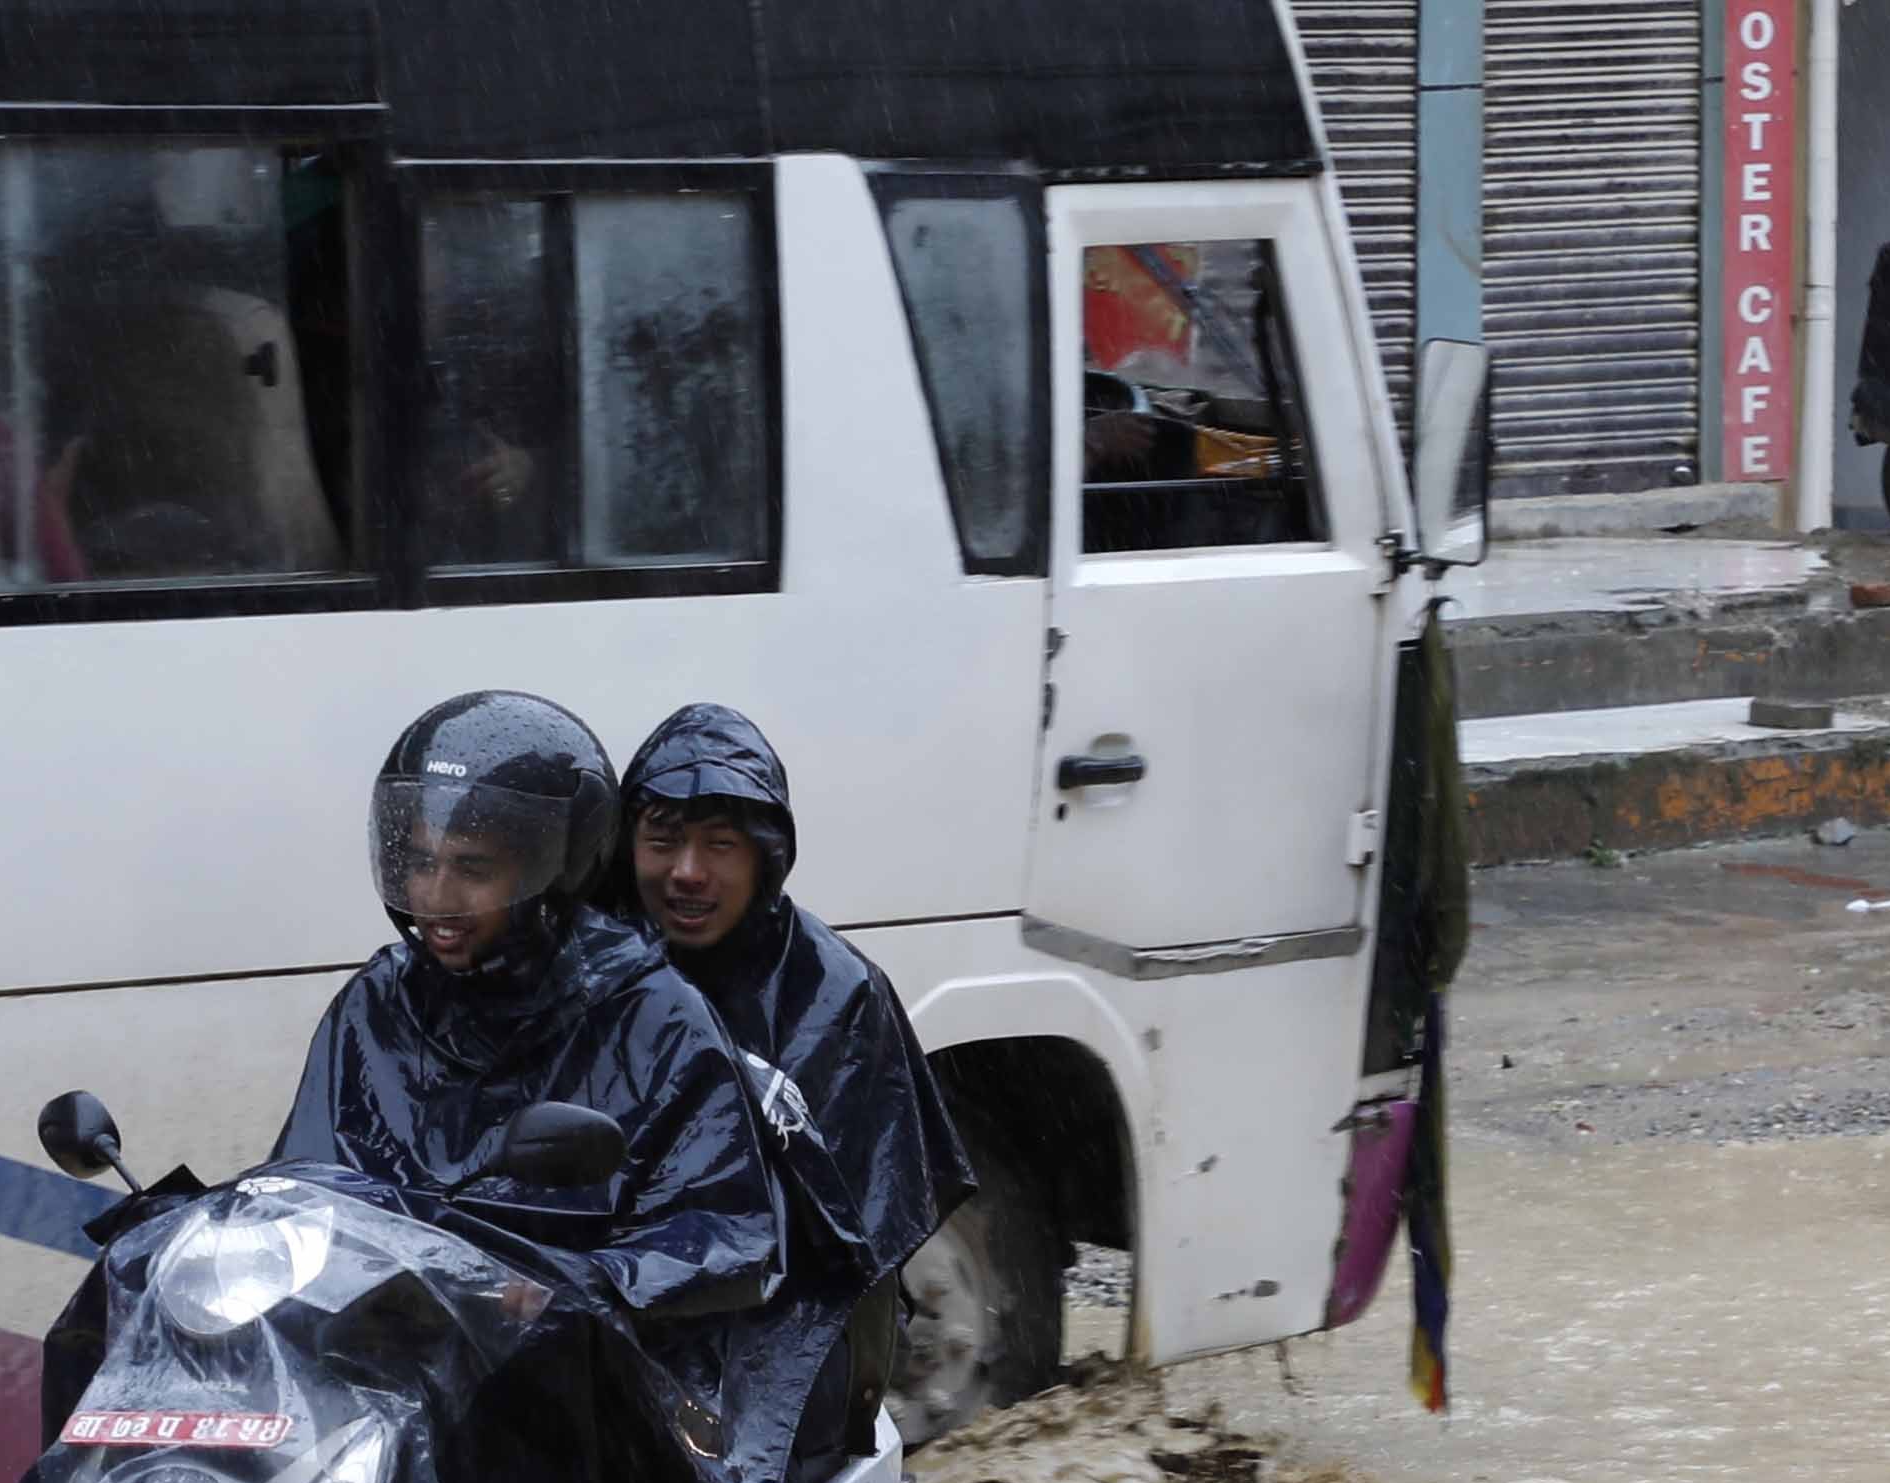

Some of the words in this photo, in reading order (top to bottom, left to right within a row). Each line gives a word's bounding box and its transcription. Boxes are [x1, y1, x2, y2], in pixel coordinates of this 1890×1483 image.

[1739, 11, 1775, 252] OSTER
[1737, 286, 1773, 474] CAFE
[427, 760, 467, 777] Hero
[72, 1416, 107, 1437] बा
[157, 1416, 184, 1438] प
